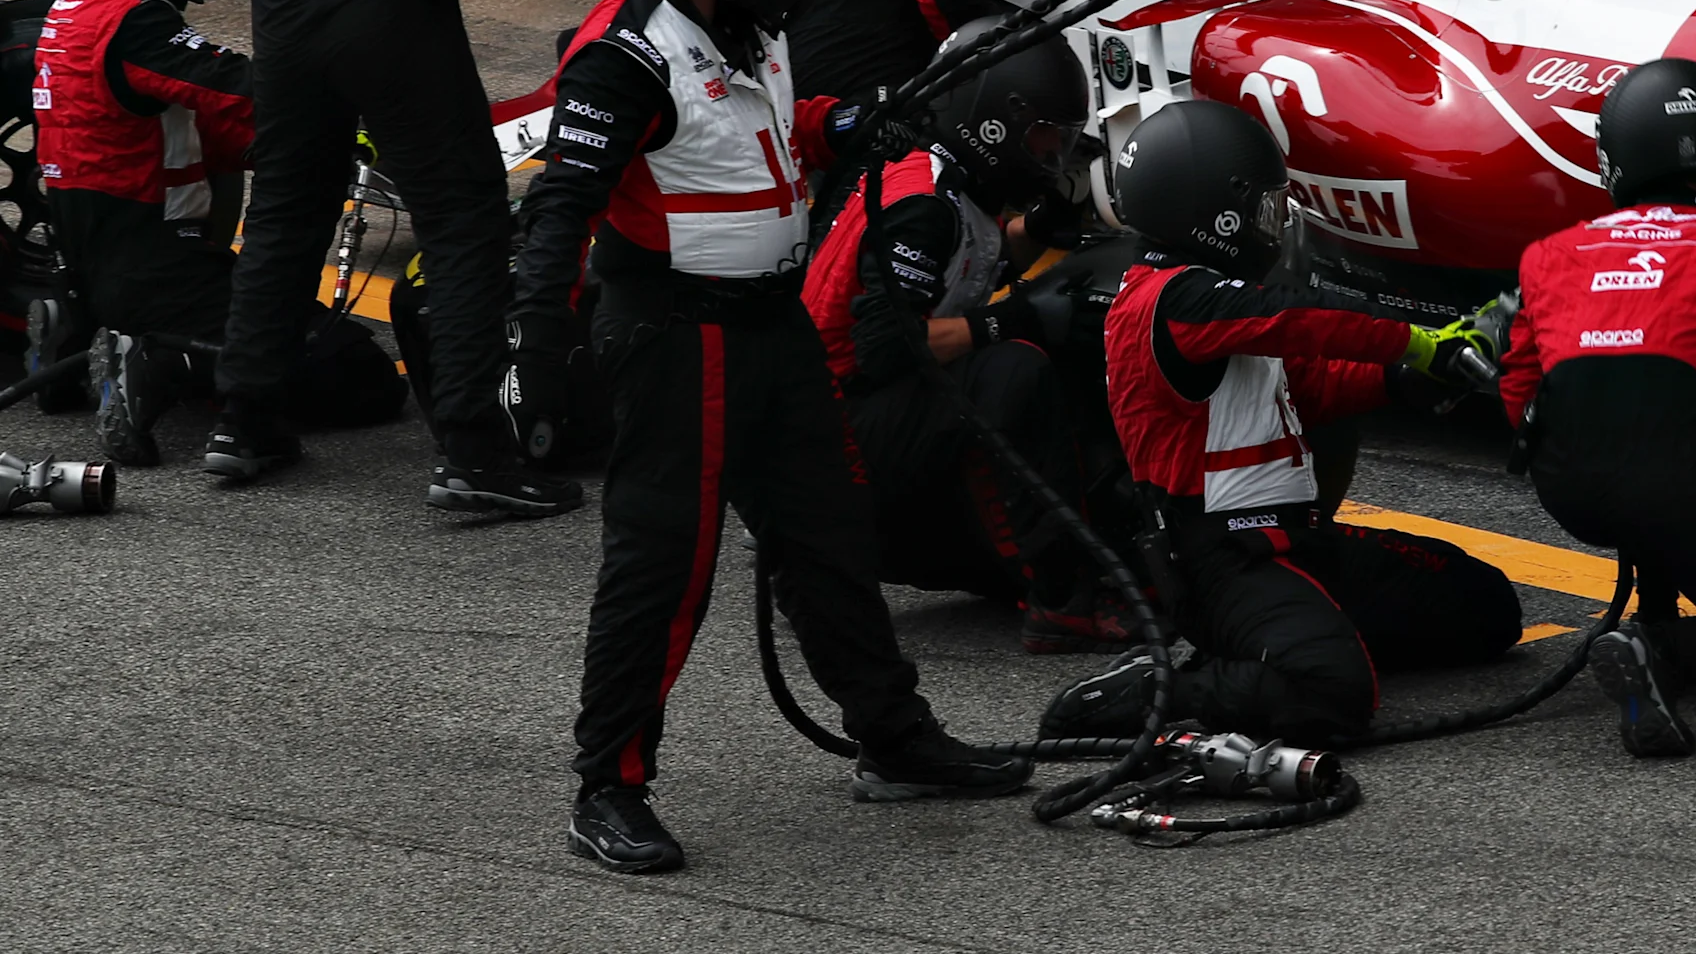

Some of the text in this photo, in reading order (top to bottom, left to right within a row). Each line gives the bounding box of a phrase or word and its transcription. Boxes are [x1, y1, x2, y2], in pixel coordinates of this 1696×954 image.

[616, 28, 664, 67] sparco
[1526, 57, 1592, 100] Alfa
[564, 98, 615, 124] zodaro
[557, 124, 609, 149] PIRELLI
[956, 123, 999, 166] IQONIQ
[1289, 181, 1405, 240] RLEN
[1190, 226, 1240, 258] IQONIQ
[1597, 274, 1655, 288] ORLEN
[1227, 513, 1279, 532] sparco
